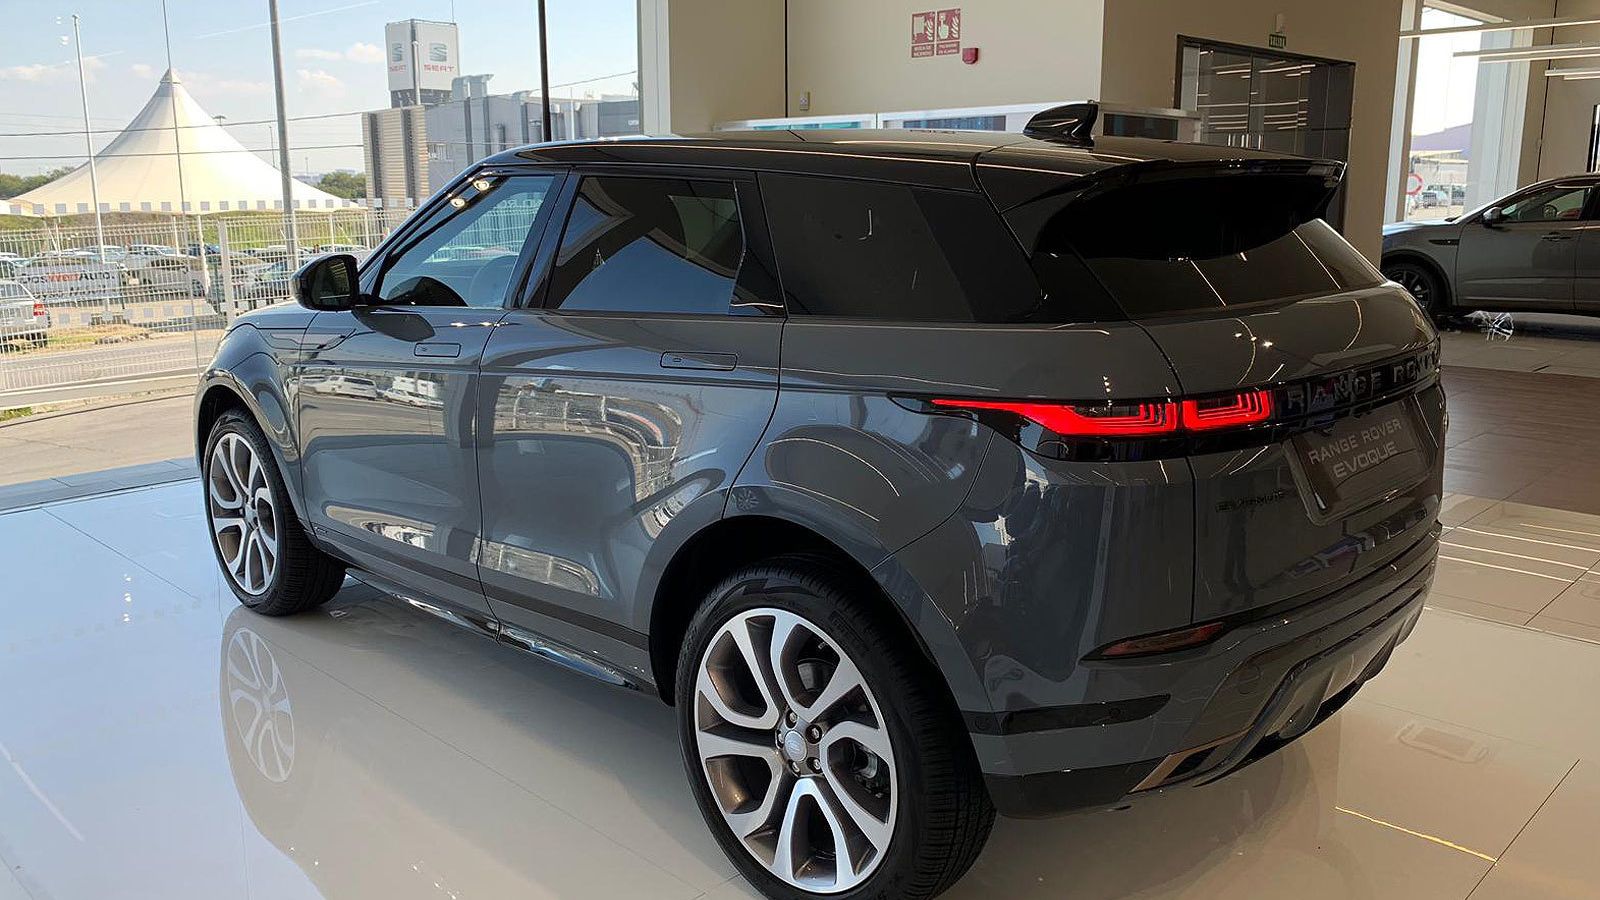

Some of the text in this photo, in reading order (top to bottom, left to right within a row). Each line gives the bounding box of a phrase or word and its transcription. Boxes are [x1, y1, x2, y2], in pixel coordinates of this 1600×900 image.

[423, 64, 455, 73] SEAT
[1287, 371, 1384, 412] RANGE
[1307, 418, 1402, 465] RANGE ROVER
[1333, 440, 1399, 478] EVOQUE
